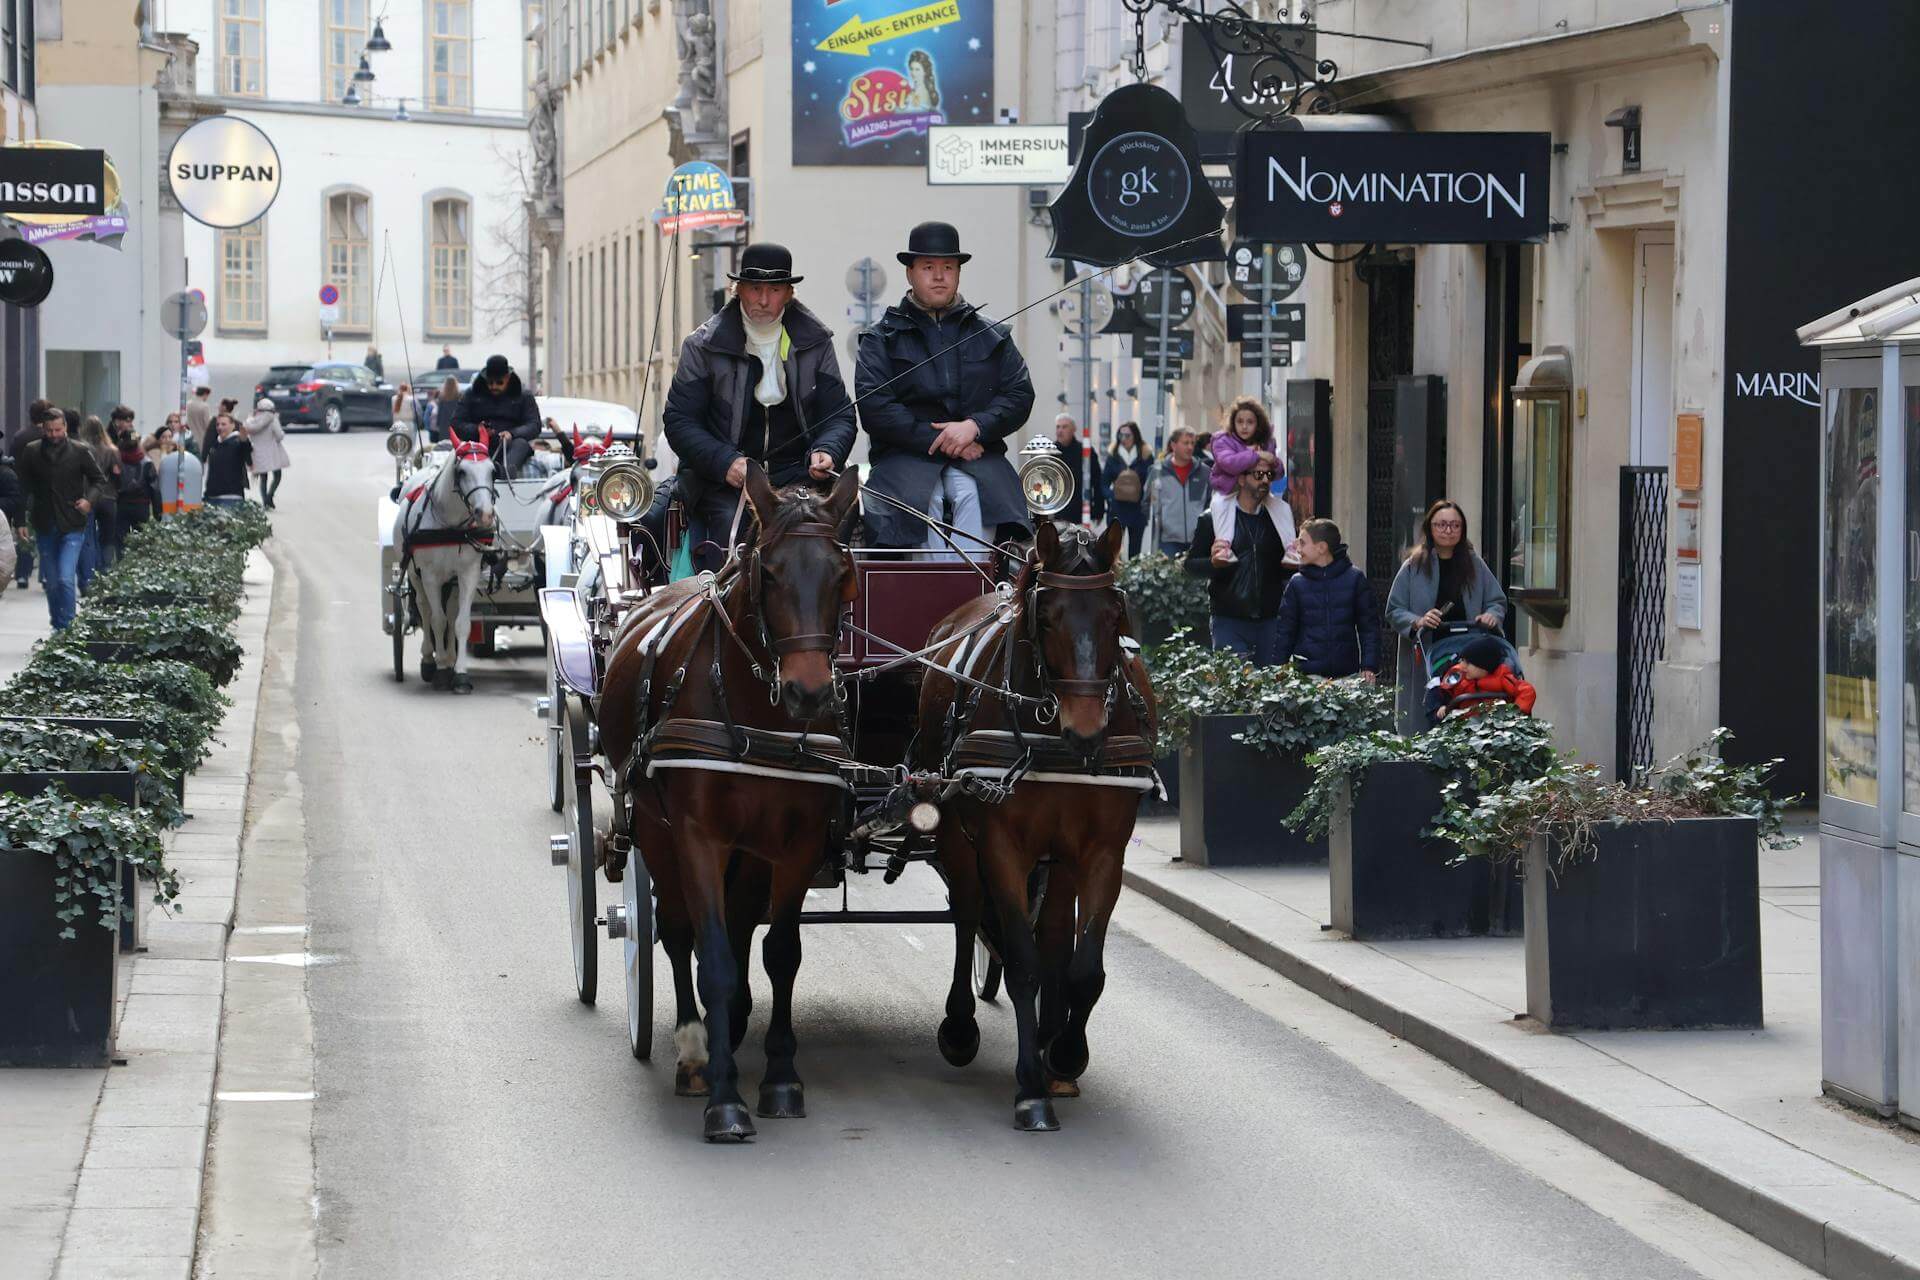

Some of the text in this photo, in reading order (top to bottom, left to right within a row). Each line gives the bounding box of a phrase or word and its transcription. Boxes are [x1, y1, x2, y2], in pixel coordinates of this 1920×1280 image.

[827, 25, 883, 50] EINGANG
[892, 4, 957, 32] ENTRANCE
[840, 76, 907, 121] Sisi
[850, 119, 889, 139] AMAZING
[1118, 140, 1161, 154] glückskind
[1627, 130, 1636, 159] 4
[176, 163, 274, 182] SUPPAN
[1118, 165, 1160, 207] gk
[664, 190, 736, 214] TRAVEL
[1267, 156, 1526, 219] NOMINATION
[23, 259, 35, 272] by
[1736, 372, 1822, 407] MARIN
